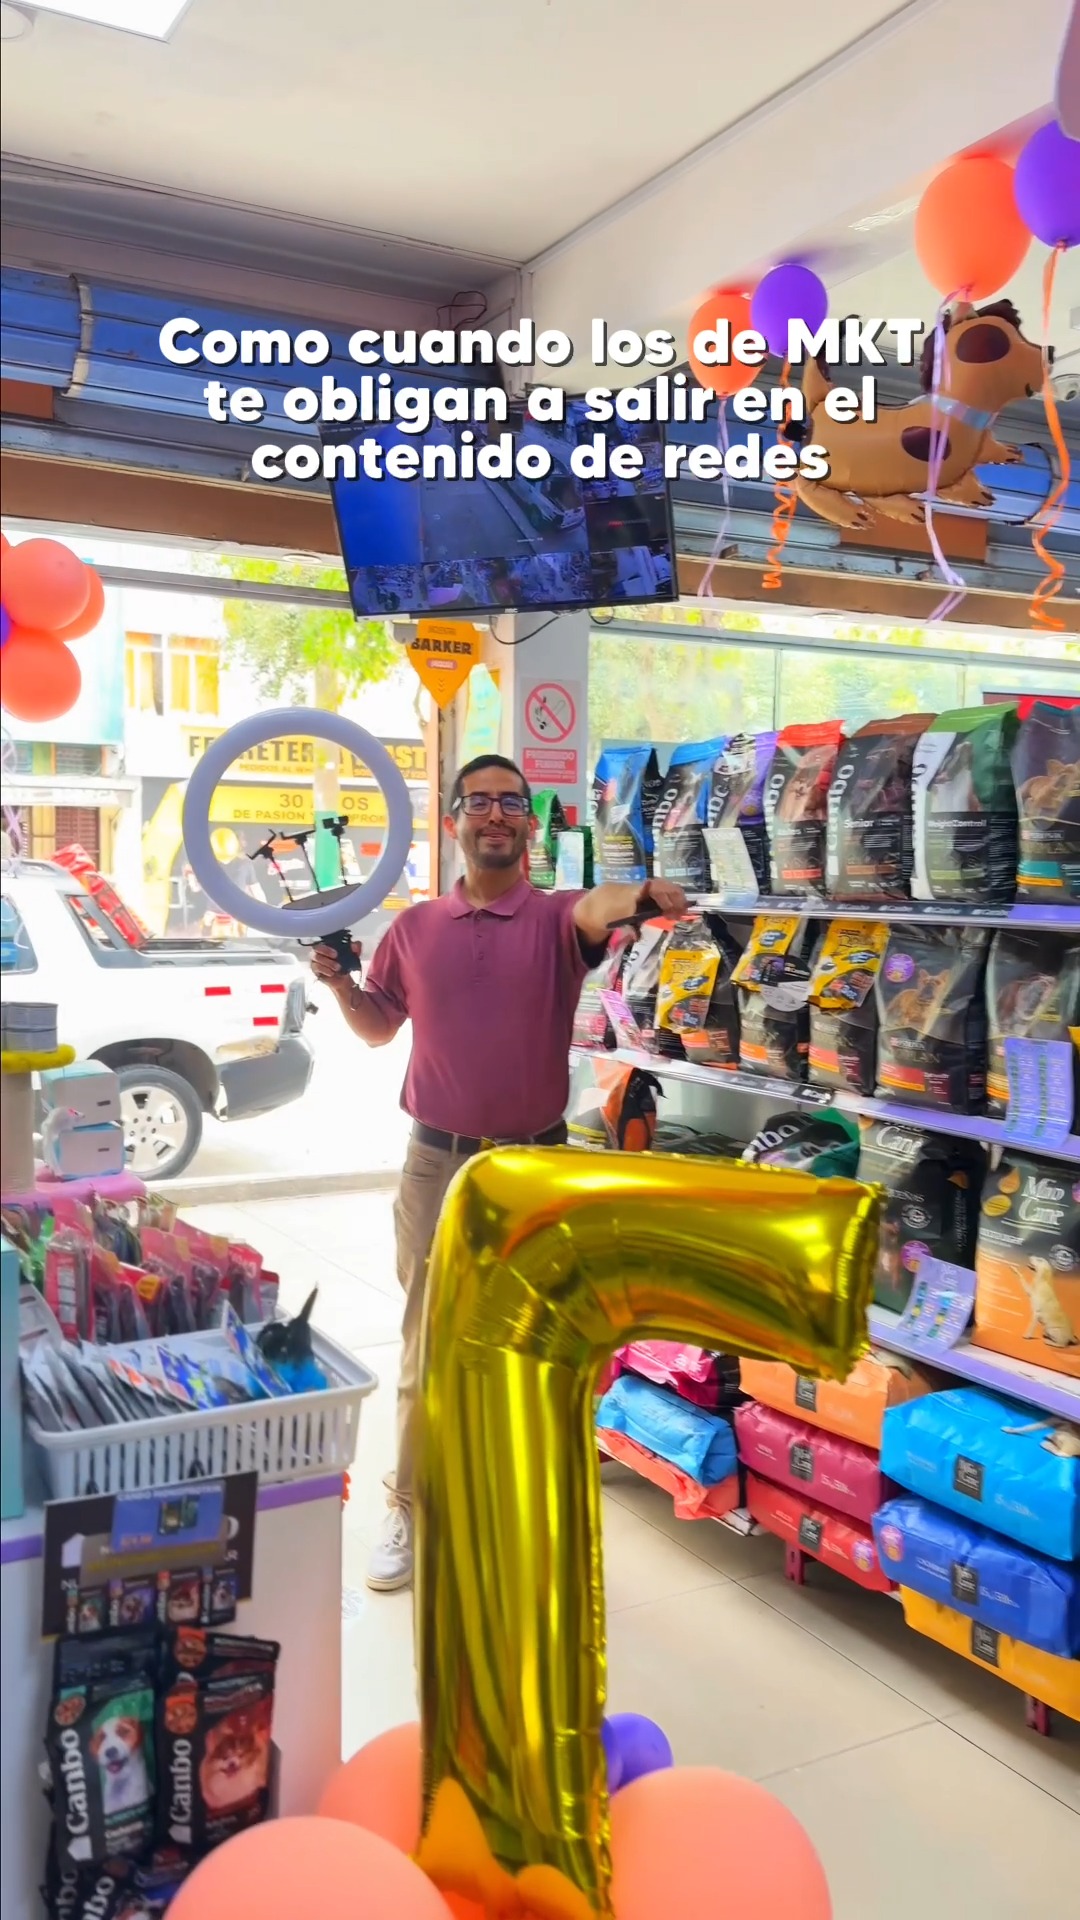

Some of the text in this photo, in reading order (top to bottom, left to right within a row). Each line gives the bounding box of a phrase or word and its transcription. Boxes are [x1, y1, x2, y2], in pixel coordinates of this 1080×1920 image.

[279, 793, 304, 808] 30
[255, 810, 306, 822] PASION
[843, 817, 875, 830] Senior
[60, 1728, 90, 1835] Canbo
[169, 1738, 193, 1824] Canbo
